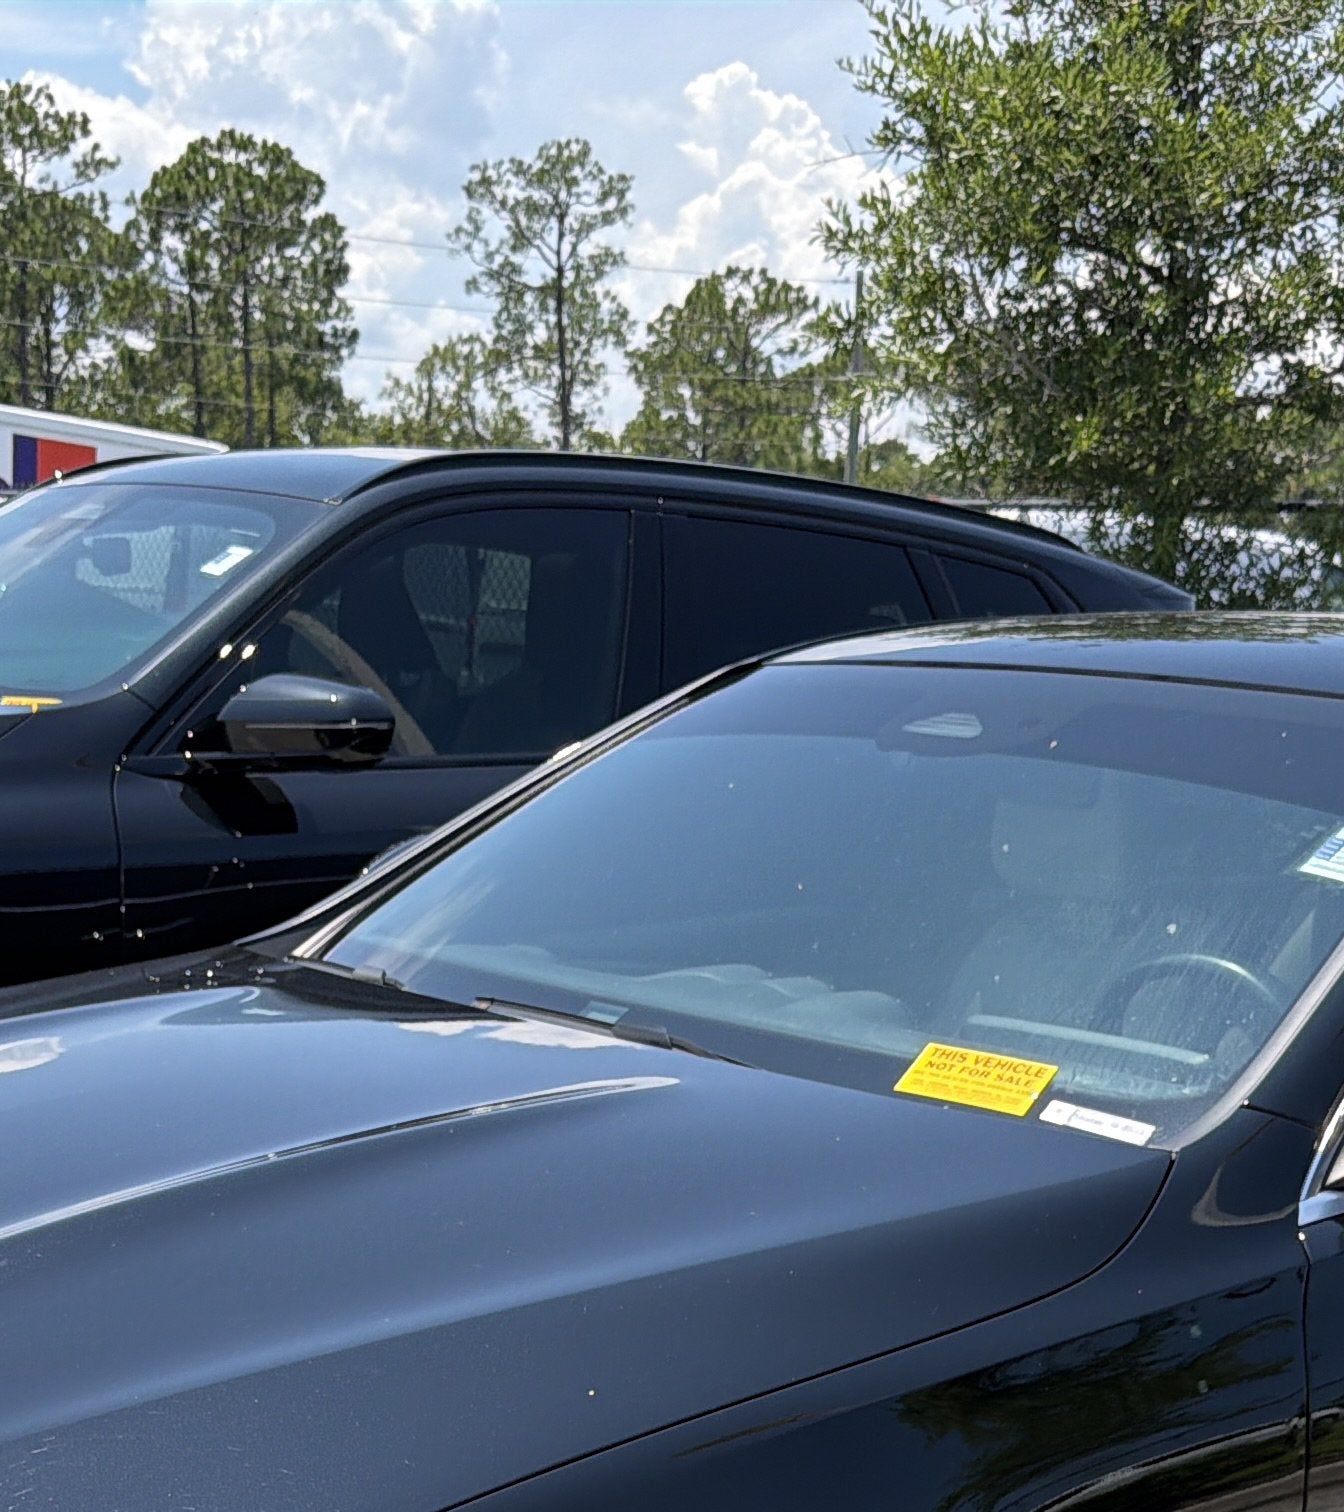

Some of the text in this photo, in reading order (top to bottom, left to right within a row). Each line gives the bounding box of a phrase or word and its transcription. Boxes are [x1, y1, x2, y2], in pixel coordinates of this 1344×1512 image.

[924, 1060, 1035, 1088] NOT FOR SALE
[930, 1047, 1048, 1079] THIS VEHICLE
